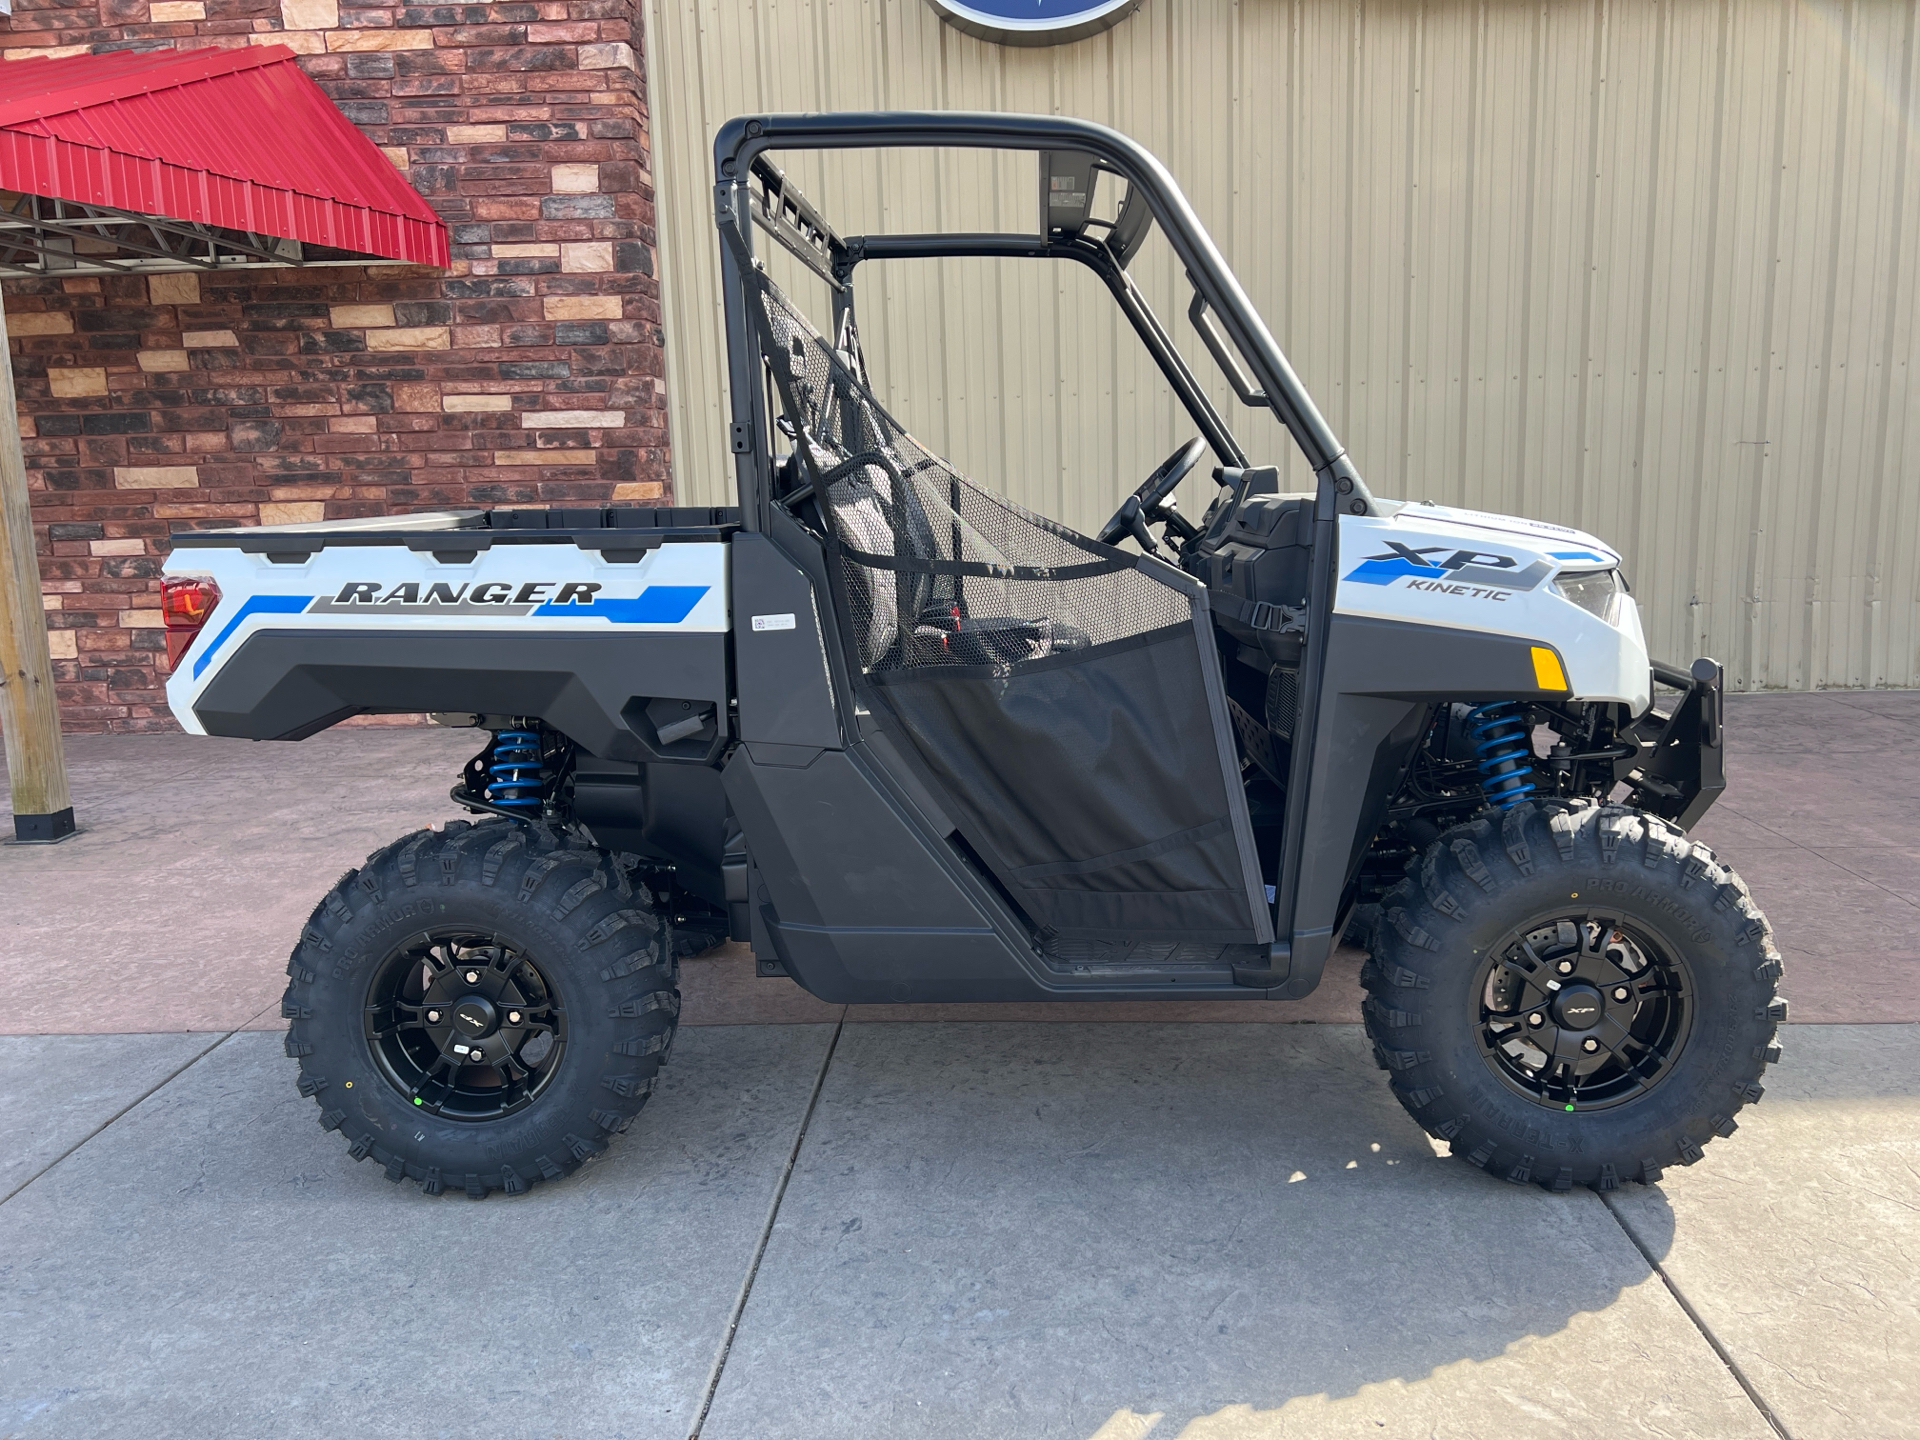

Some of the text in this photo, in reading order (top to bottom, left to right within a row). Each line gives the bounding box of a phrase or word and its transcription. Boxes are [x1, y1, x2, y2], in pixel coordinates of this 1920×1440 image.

[1360, 540, 1518, 570] XP
[332, 582, 603, 605] RANGER
[1405, 579, 1512, 602] KINETIC
[1586, 877, 1700, 930] PRO ARMOR
[331, 904, 417, 981] PRO ARMOR
[459, 1013, 484, 1028] XP
[1465, 1085, 1584, 1154] X-TERRAIN
